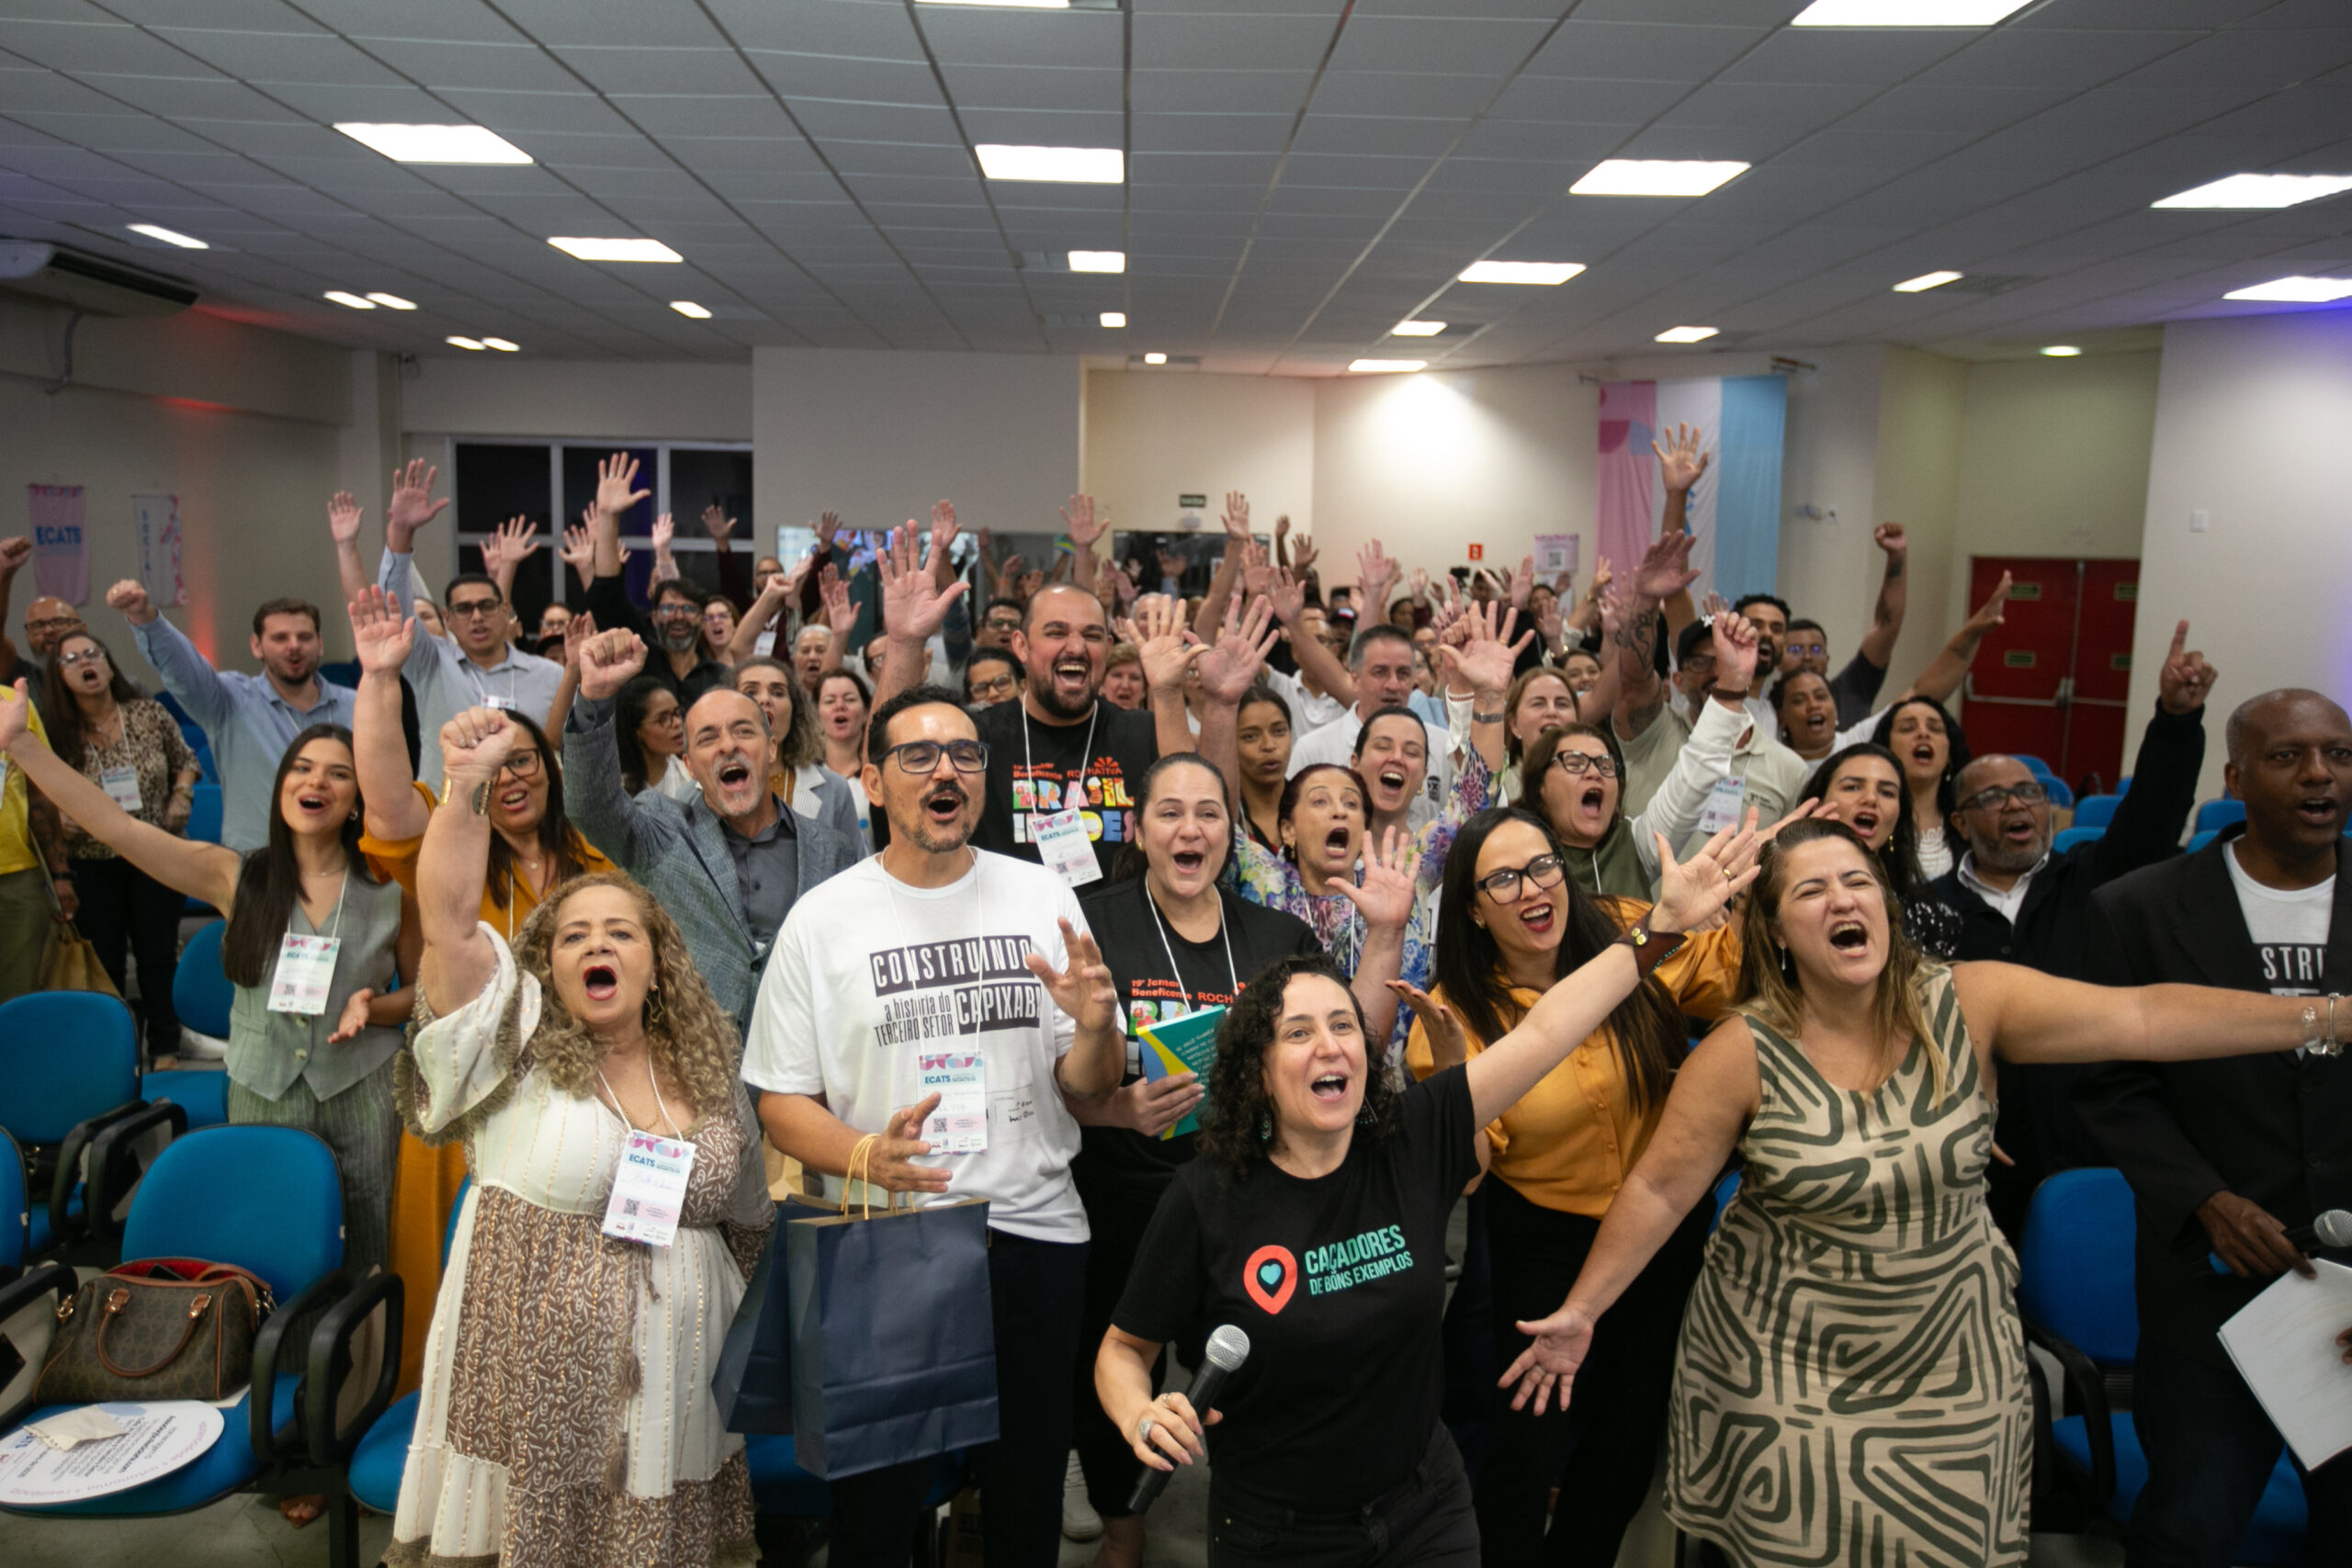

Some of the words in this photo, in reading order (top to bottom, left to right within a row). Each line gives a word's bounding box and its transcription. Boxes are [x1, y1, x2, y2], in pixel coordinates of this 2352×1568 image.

[36, 525, 82, 546] ECATS
[1067, 767, 1123, 778] ROHATIVA
[1012, 776, 1135, 809] BRASIL
[873, 938, 1031, 988] CONSTRUINDO
[884, 1004, 892, 1022] a
[938, 991, 952, 1013] do
[1131, 987, 1193, 1000] Beneficene
[874, 1018, 921, 1047] TERCEIRO
[922, 1013, 955, 1039] SETOR
[924, 1075, 951, 1084] ECATS
[628, 1153, 655, 1168] ECATS
[1305, 1224, 1407, 1275] CAÇADORES
[1308, 1277, 1324, 1296] DE
[1324, 1271, 1353, 1293] BONS
[1352, 1250, 1414, 1284] EXEMPLOS
